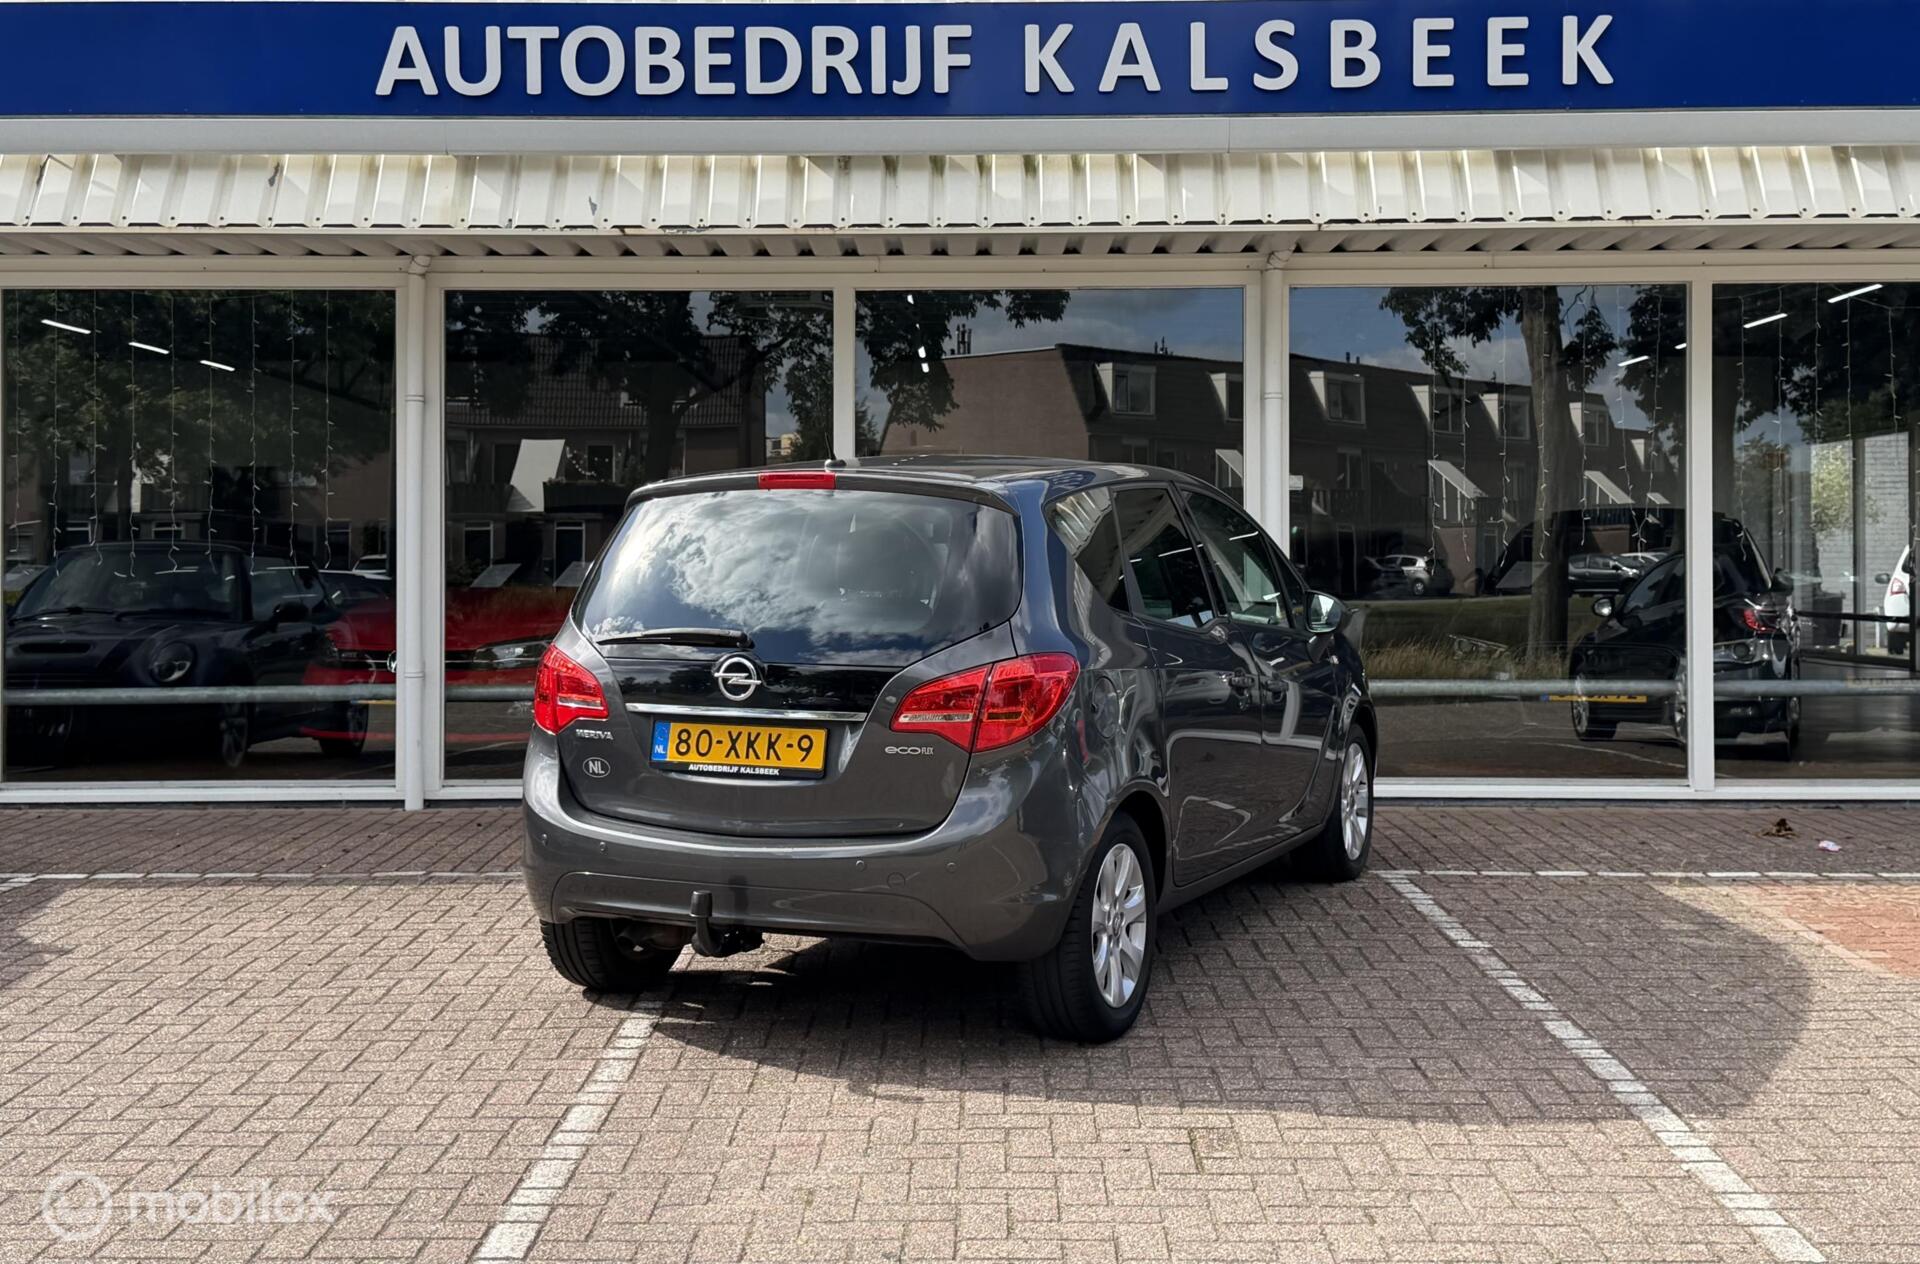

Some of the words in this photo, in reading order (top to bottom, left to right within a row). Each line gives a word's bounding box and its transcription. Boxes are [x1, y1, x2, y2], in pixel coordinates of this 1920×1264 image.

[374, 24, 974, 97] AUTOBEDRIJF
[1023, 14, 1615, 94] KALSBEEK
[576, 729, 614, 740] MERIVA
[654, 745, 666, 754] NL
[674, 728, 814, 762] 80-XKK-9
[588, 760, 605, 774] NL
[688, 763, 739, 774] AUTOBEDRIJF
[740, 766, 780, 776] KALSBEEK
